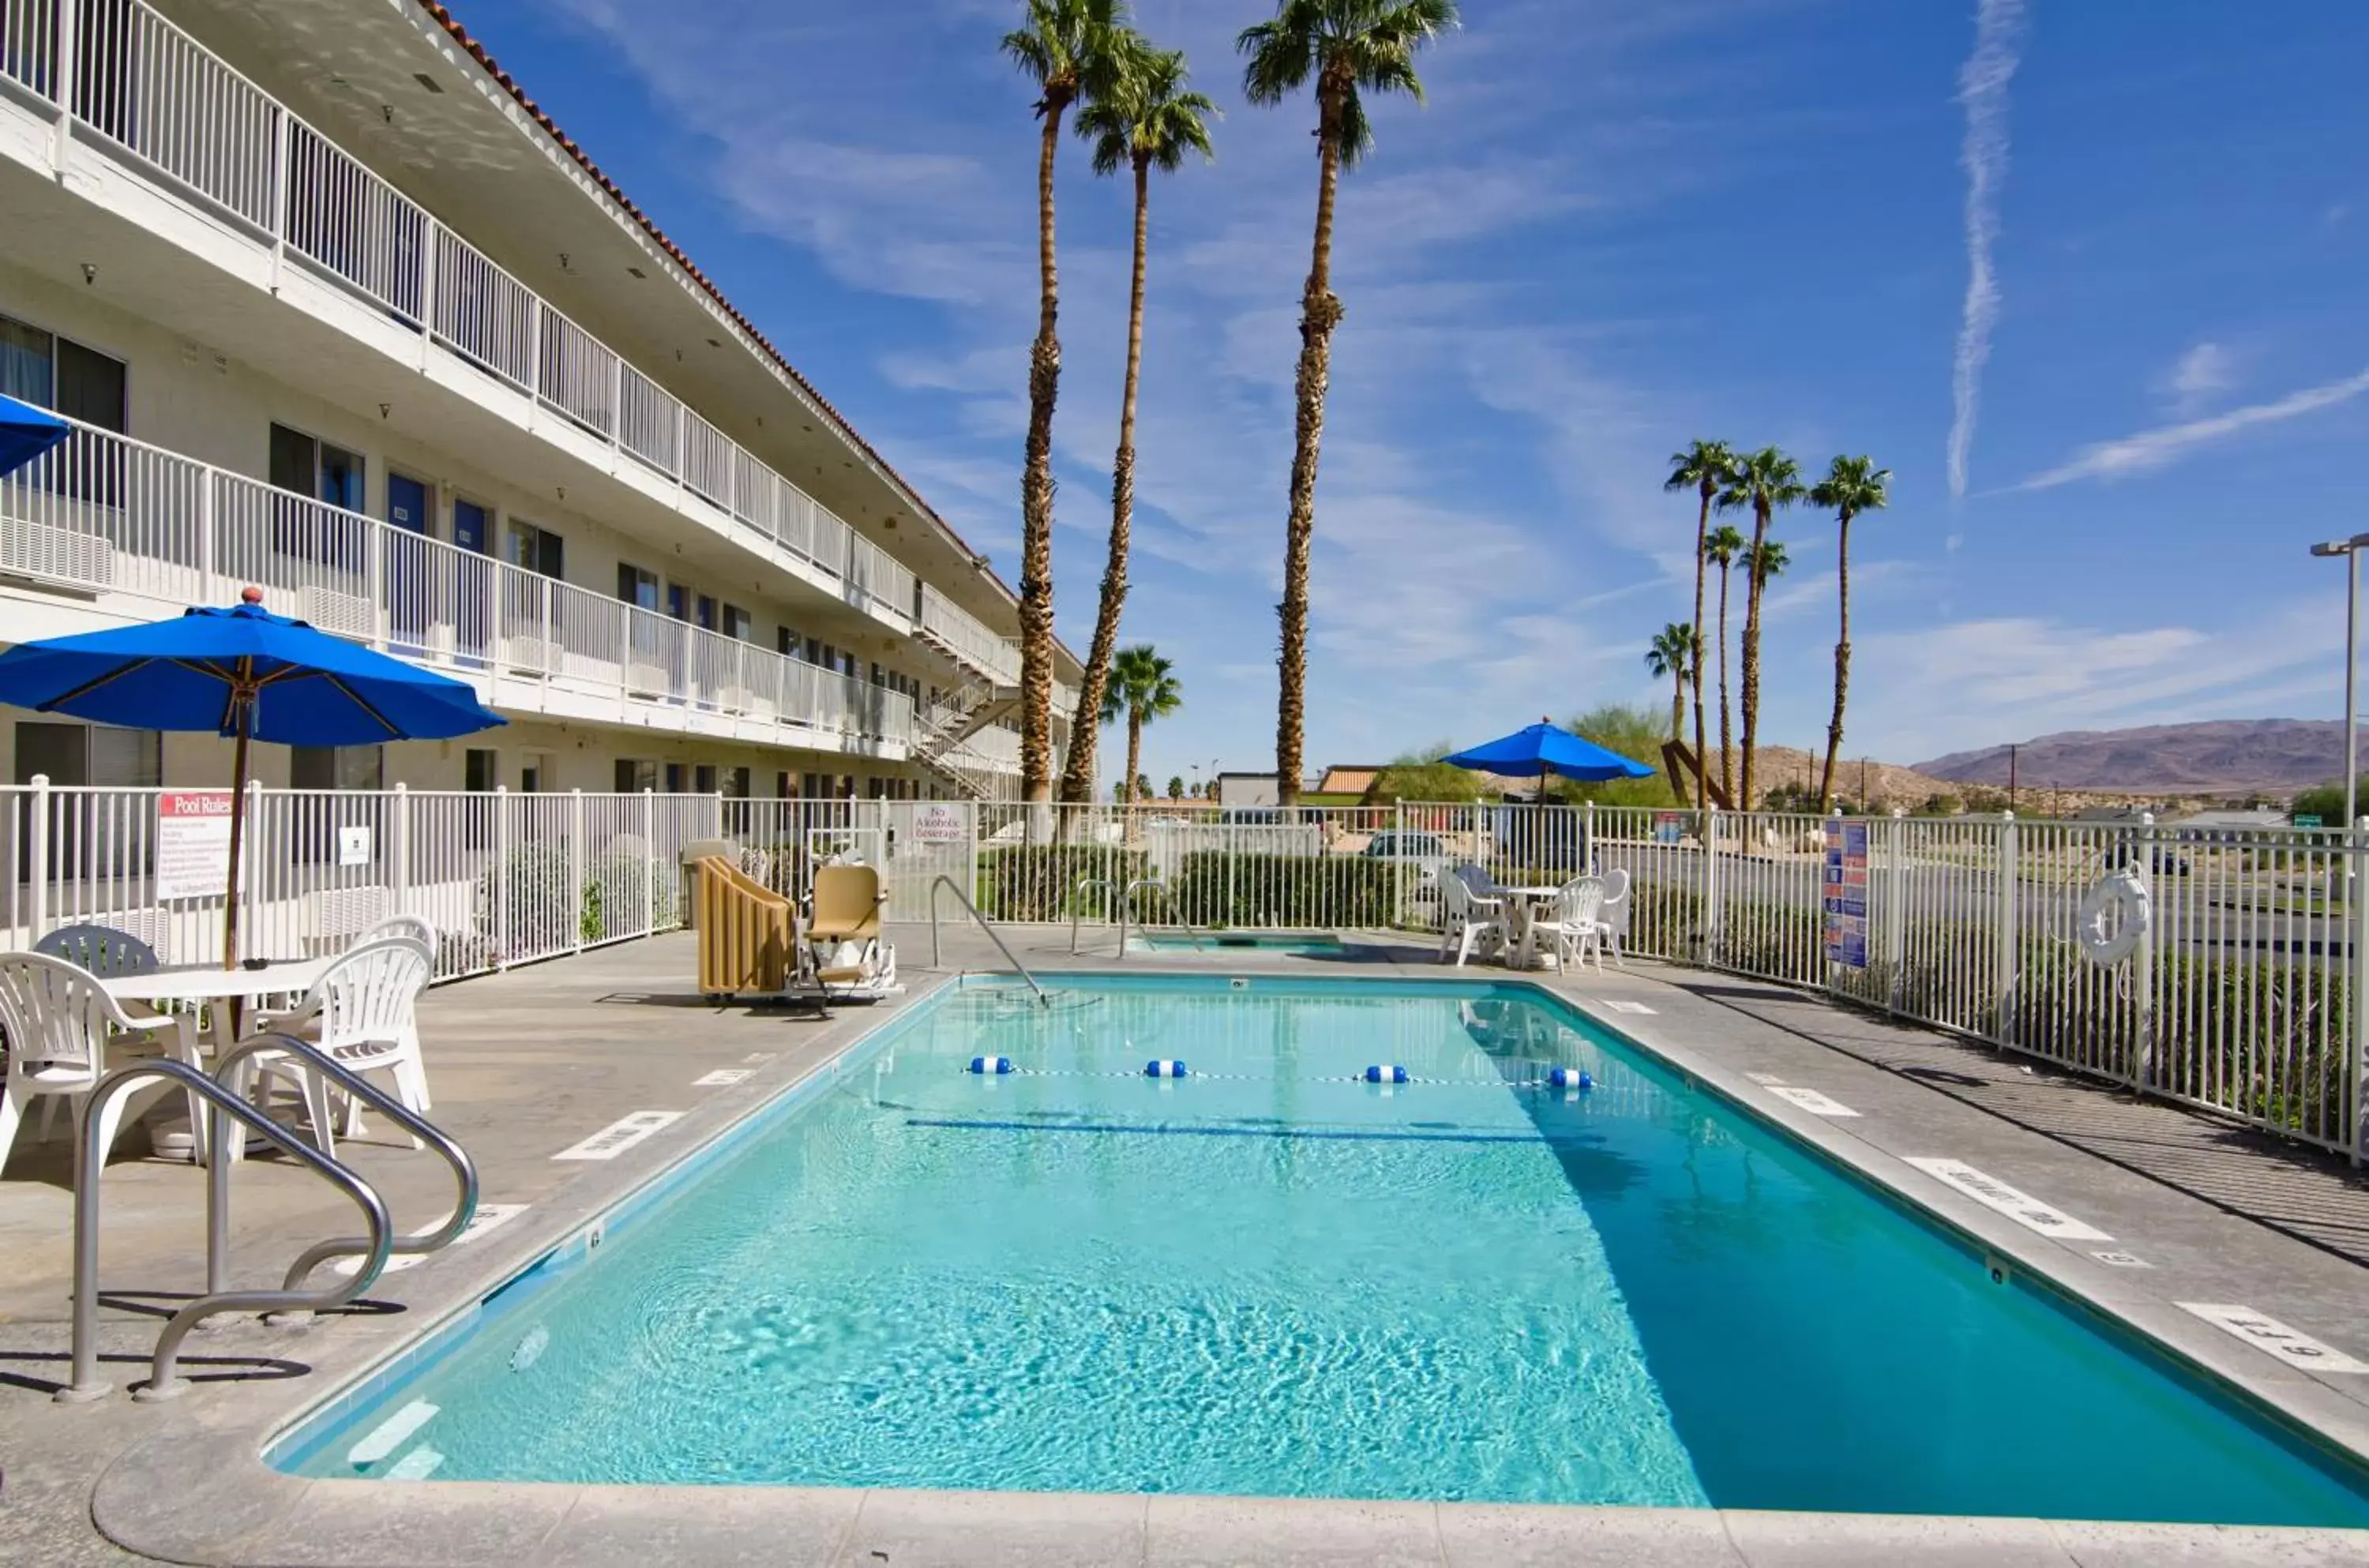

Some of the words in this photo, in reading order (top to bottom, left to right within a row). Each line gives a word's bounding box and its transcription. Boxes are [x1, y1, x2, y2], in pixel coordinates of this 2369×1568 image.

[174, 795, 201, 814] Pool
[201, 795, 234, 815] Rules
[930, 807, 946, 817] No
[916, 816, 960, 828] Alcoholic
